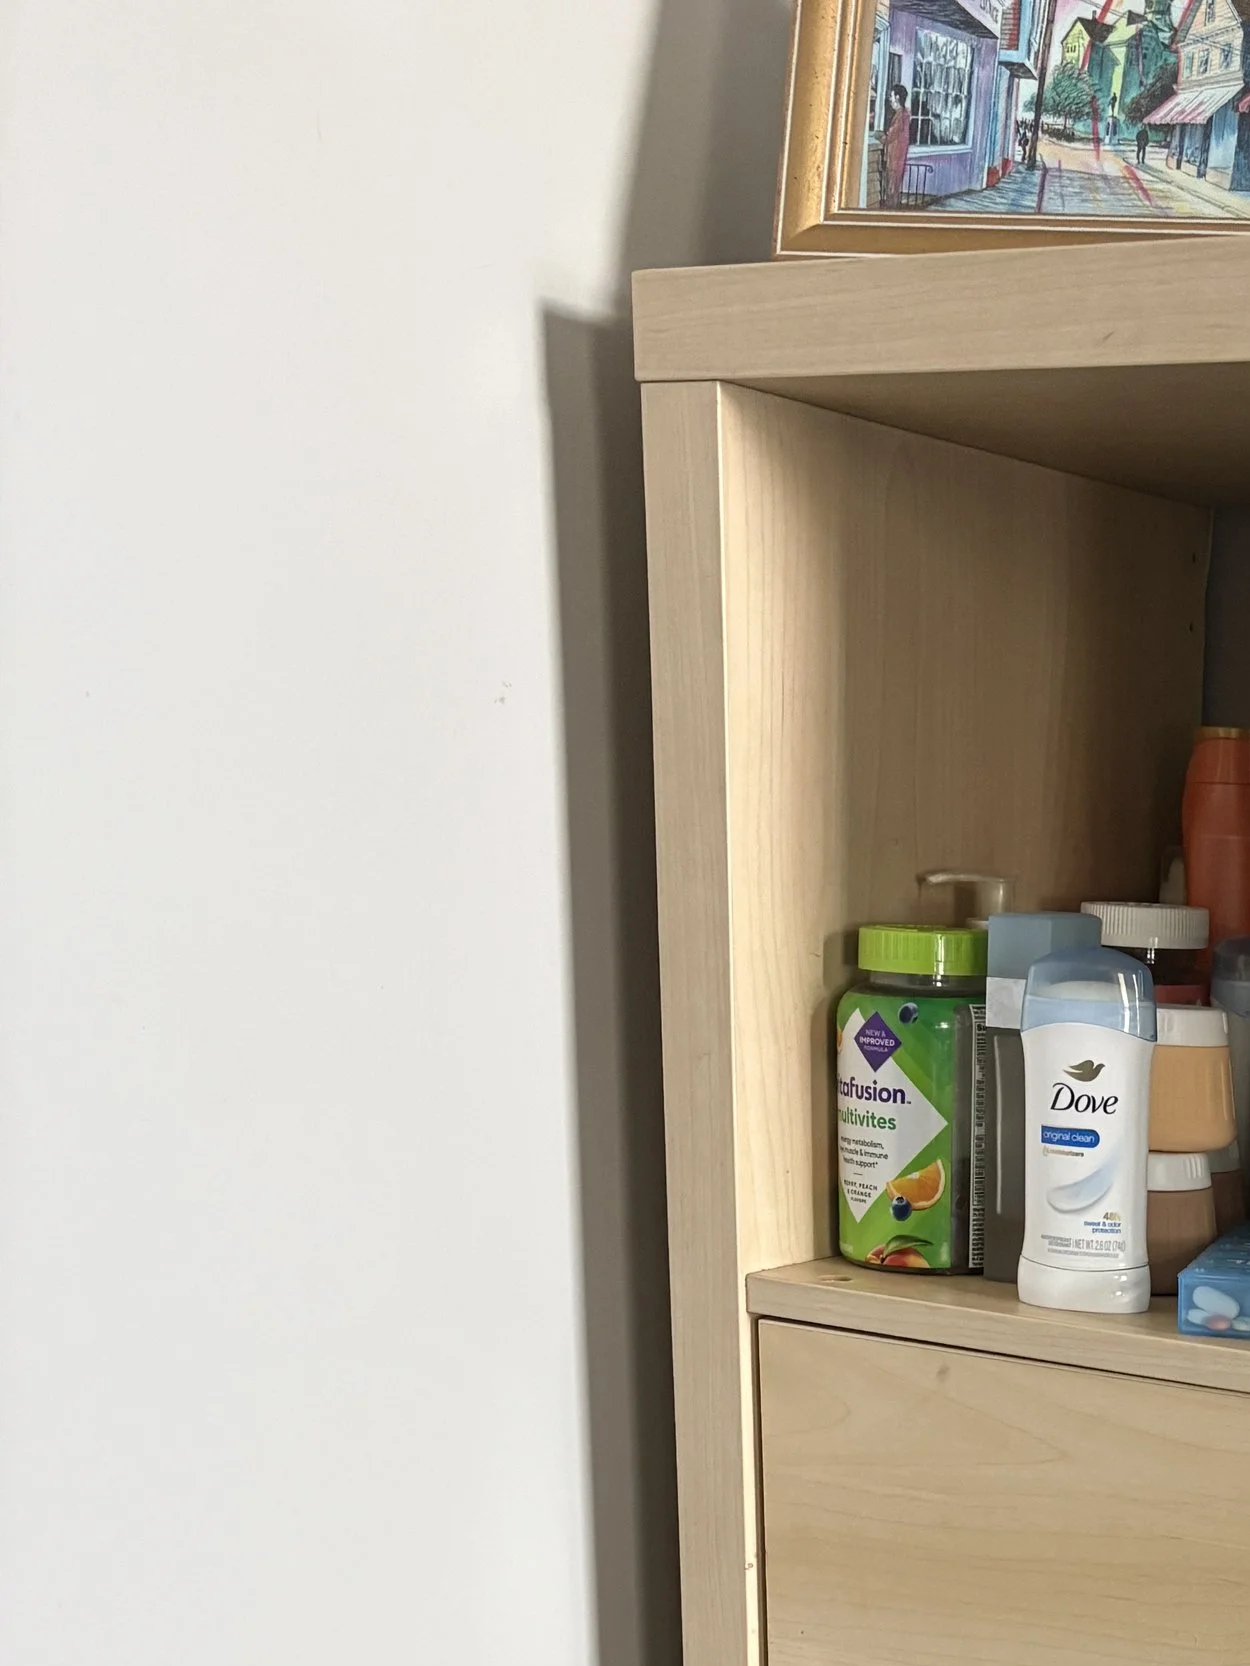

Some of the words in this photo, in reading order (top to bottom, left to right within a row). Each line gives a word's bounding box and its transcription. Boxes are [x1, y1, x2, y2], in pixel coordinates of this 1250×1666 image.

[859, 1037, 896, 1047] IMPROVED
[839, 1076, 906, 1105] tafusion
[1050, 1082, 1119, 1115] Dove
[1043, 1130, 1070, 1142] original
[1071, 1134, 1095, 1143] clean
